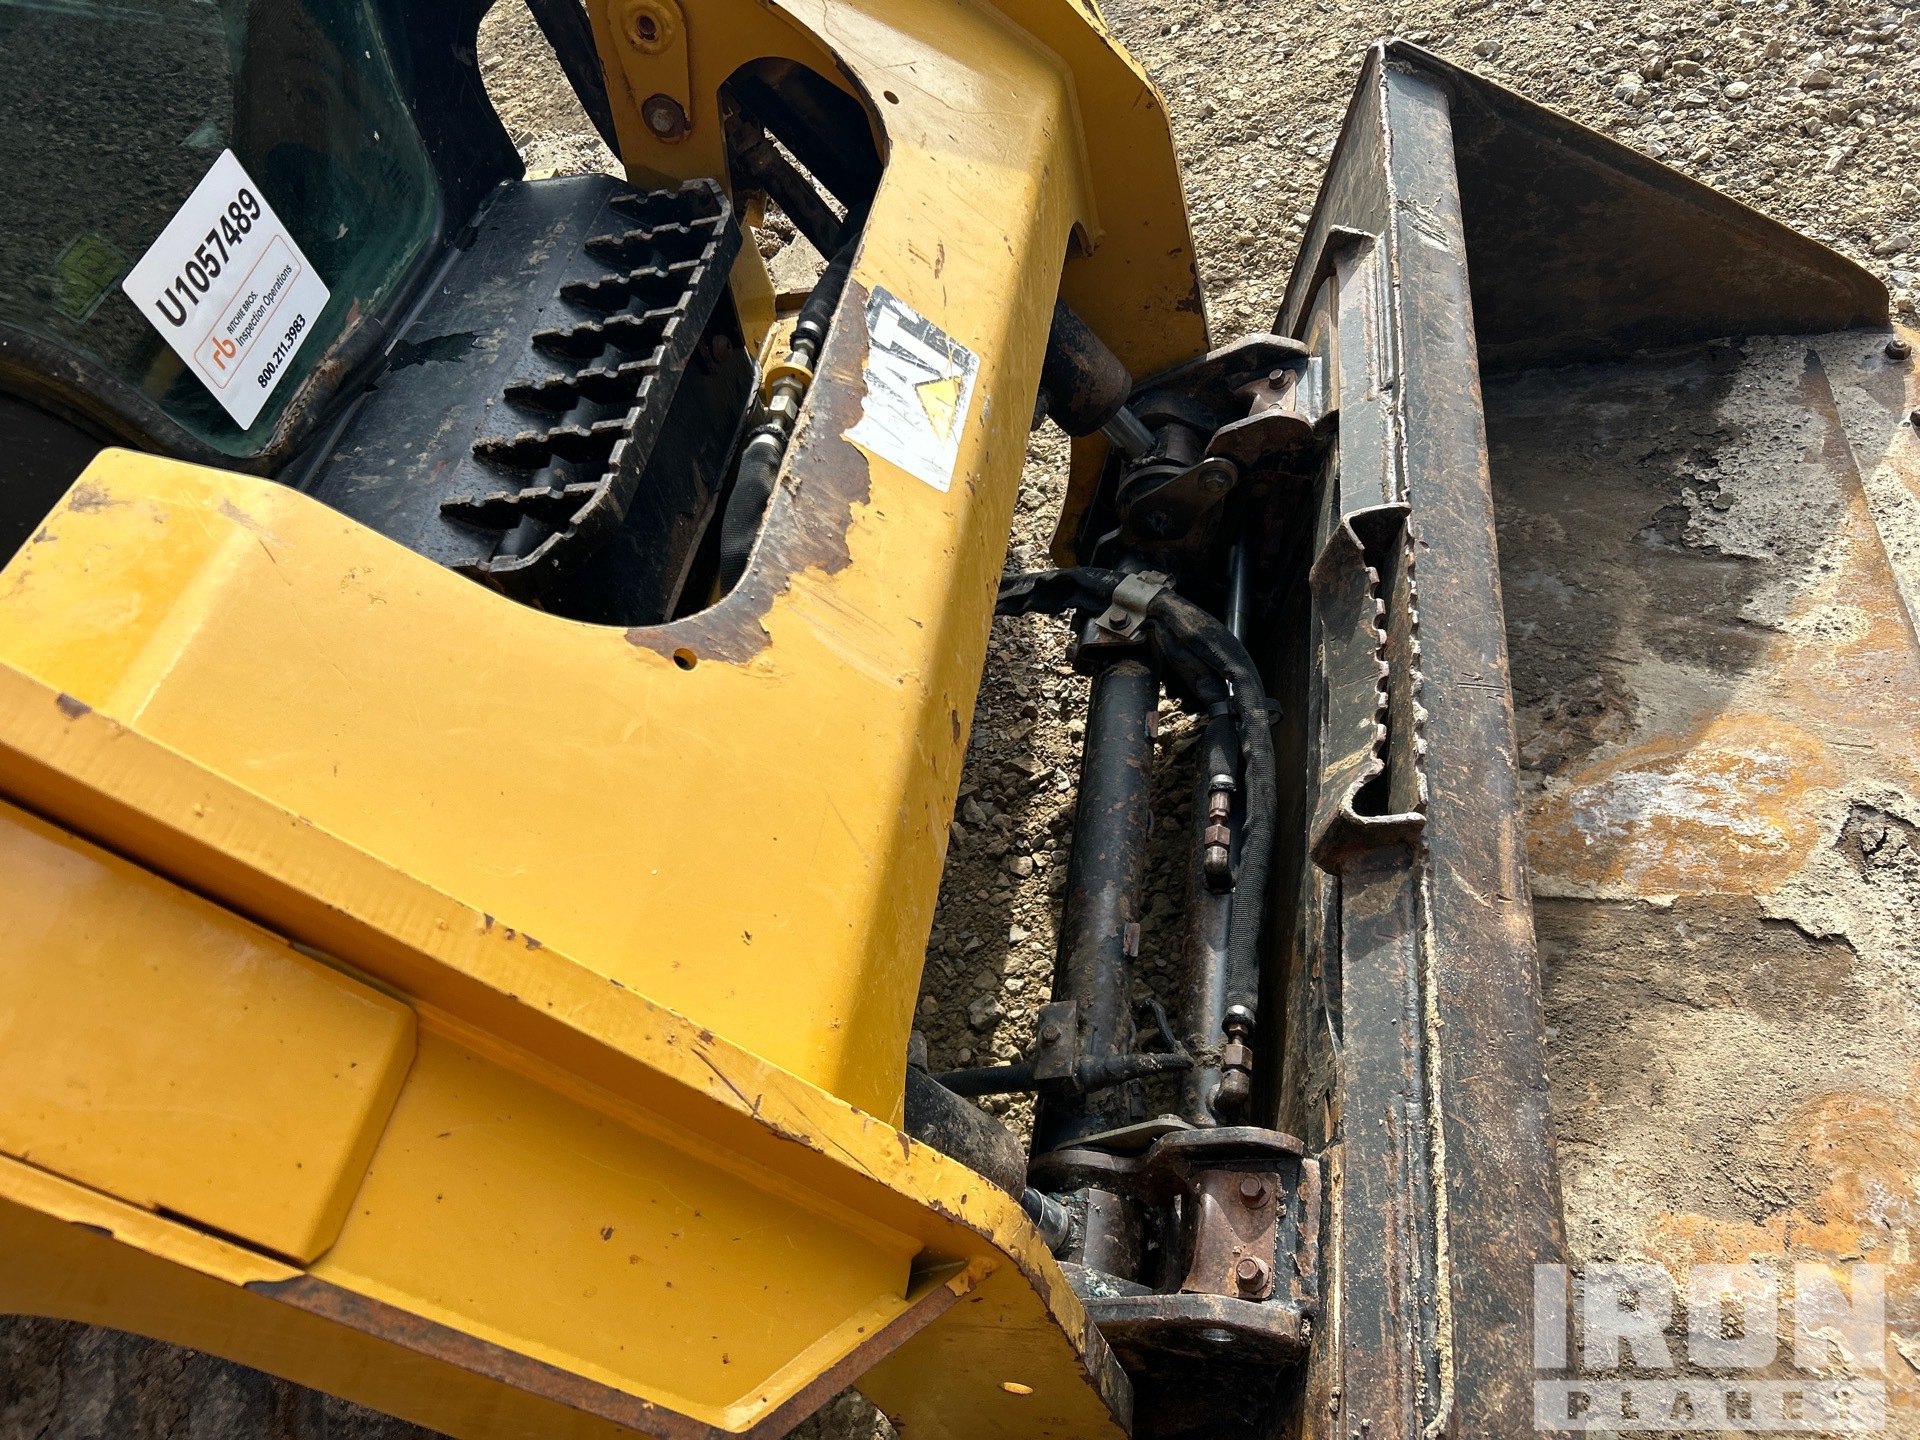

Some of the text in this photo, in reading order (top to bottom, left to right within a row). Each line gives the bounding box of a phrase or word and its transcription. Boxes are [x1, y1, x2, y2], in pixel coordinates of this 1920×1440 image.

[155, 188, 261, 328] U1057489
[226, 290, 259, 335] RITCHIE BROS.
[235, 264, 293, 347] Inspection Operations
[211, 336, 237, 371] rb
[257, 313, 306, 388] 800.211.3983
